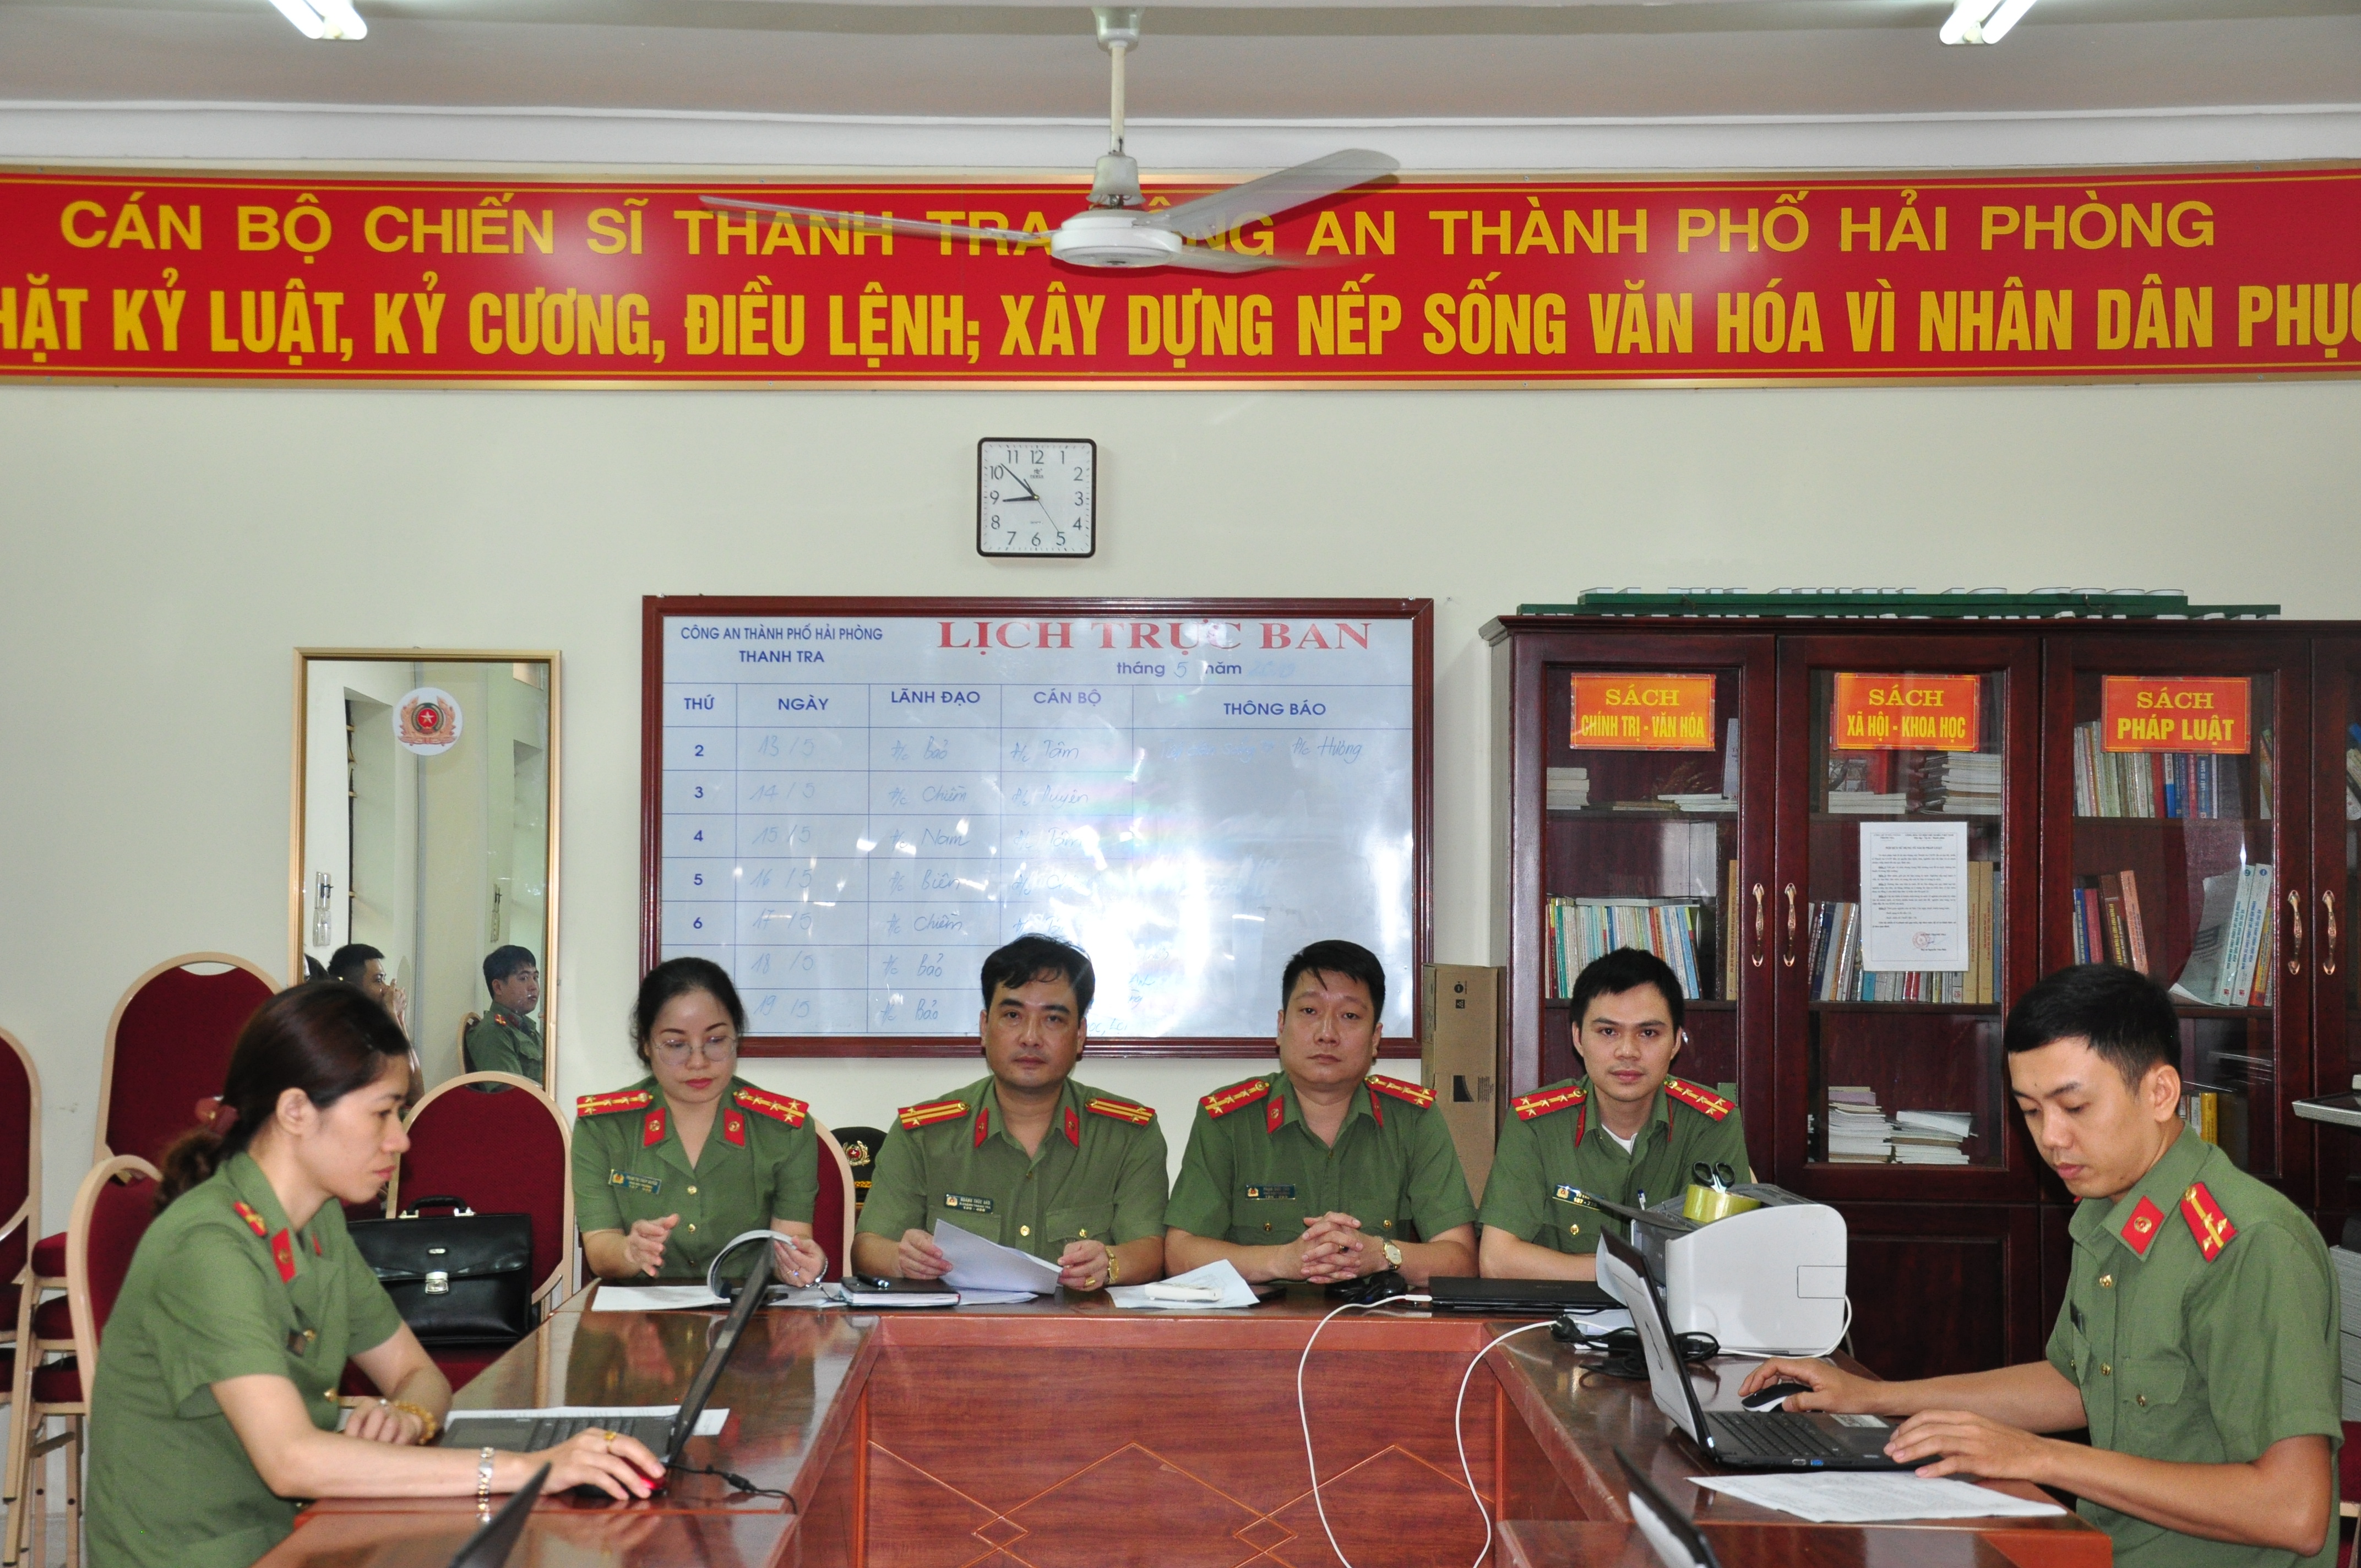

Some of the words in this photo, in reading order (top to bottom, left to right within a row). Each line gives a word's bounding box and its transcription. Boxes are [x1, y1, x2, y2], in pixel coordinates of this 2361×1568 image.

[61, 191, 202, 251] CÁN
[238, 193, 331, 264] BỘ
[364, 192, 553, 254] CHIẾN
[587, 198, 649, 254] SĨ
[673, 210, 893, 255] THANH
[926, 211, 1053, 255] TRA
[1306, 211, 1395, 255] AN
[1429, 195, 1647, 254] THÀNH
[1678, 190, 1810, 252] PHỐ
[1841, 189, 1947, 252] HẢI
[1982, 190, 2215, 250] PHÒNG
[113, 267, 186, 351] KỶ
[210, 278, 353, 366] LUẬT,
[374, 270, 446, 354] KỶ
[469, 286, 665, 363] CƯƠNG,
[684, 275, 805, 356] ĐIỀU
[829, 281, 980, 368] LỆNH;
[999, 281, 1106, 356] XÂY
[1128, 287, 1272, 368] DỰNG
[1298, 273, 1402, 356] NẾP
[1423, 271, 1566, 356] SỐNG
[1589, 279, 1693, 354] VĂN
[1717, 277, 1824, 353] HÓA
[1846, 278, 1895, 352] VÌ
[1919, 276, 2072, 351] NHÂN
[2097, 273, 2212, 350] DÂN
[1008, 450, 1018, 464] 11
[1030, 450, 1044, 464] 12
[1060, 450, 1064, 464] 1
[991, 465, 1004, 480] 10
[1074, 467, 1082, 481] 2
[990, 491, 999, 504] 9
[1075, 491, 1083, 506] 3
[991, 515, 1000, 530] 8
[1073, 516, 1082, 530] 4
[1007, 531, 1016, 545] 7
[1031, 532, 1041, 546] 6
[1056, 531, 1065, 546] 5
[681, 625, 720, 640] CÔNG
[723, 628, 741, 640] AN
[743, 625, 784, 640] THÀNH
[787, 624, 812, 640] PHỐ
[815, 625, 835, 640] HẢI
[839, 625, 883, 641] PHÒNG
[938, 622, 1073, 655] LỊCH
[1091, 619, 1241, 656] TRỰC
[1259, 623, 1372, 649] BAN
[739, 650, 792, 663] THANH
[796, 650, 825, 663] TRA
[1117, 662, 1165, 677] tháng
[1173, 661, 1188, 678] 5
[1205, 662, 1242, 674] năm
[683, 694, 715, 710] THỨ
[778, 694, 829, 711] NGÀY
[891, 689, 935, 704] LÃNH
[940, 690, 981, 706] ĐẠO
[1033, 689, 1071, 704] CÁN
[1078, 689, 1101, 707] BỘ
[1606, 685, 1680, 707] SÁCH
[1869, 684, 1944, 706] SÁCH
[2137, 687, 2213, 709] SÁCH
[1223, 700, 1285, 716] THÔNG
[1290, 700, 1327, 716] BÁO
[1581, 712, 1618, 738] CHÍNH
[1621, 715, 1641, 742] TRỊ
[1652, 712, 1677, 738] VĂN
[1680, 711, 1705, 738] HÓA
[1847, 714, 1865, 737] XÃ
[1867, 714, 1889, 742] HỘI
[1901, 716, 1936, 738] KHOA
[1939, 716, 1966, 743] HỌC
[2117, 712, 2175, 740] PHÁP
[2182, 714, 2234, 745] LUẬT
[694, 744, 704, 757] 2
[694, 786, 704, 799] 3
[693, 830, 704, 842] 4
[921, 828, 971, 846] Nam
[694, 873, 704, 886] 5
[693, 917, 703, 929] 6
